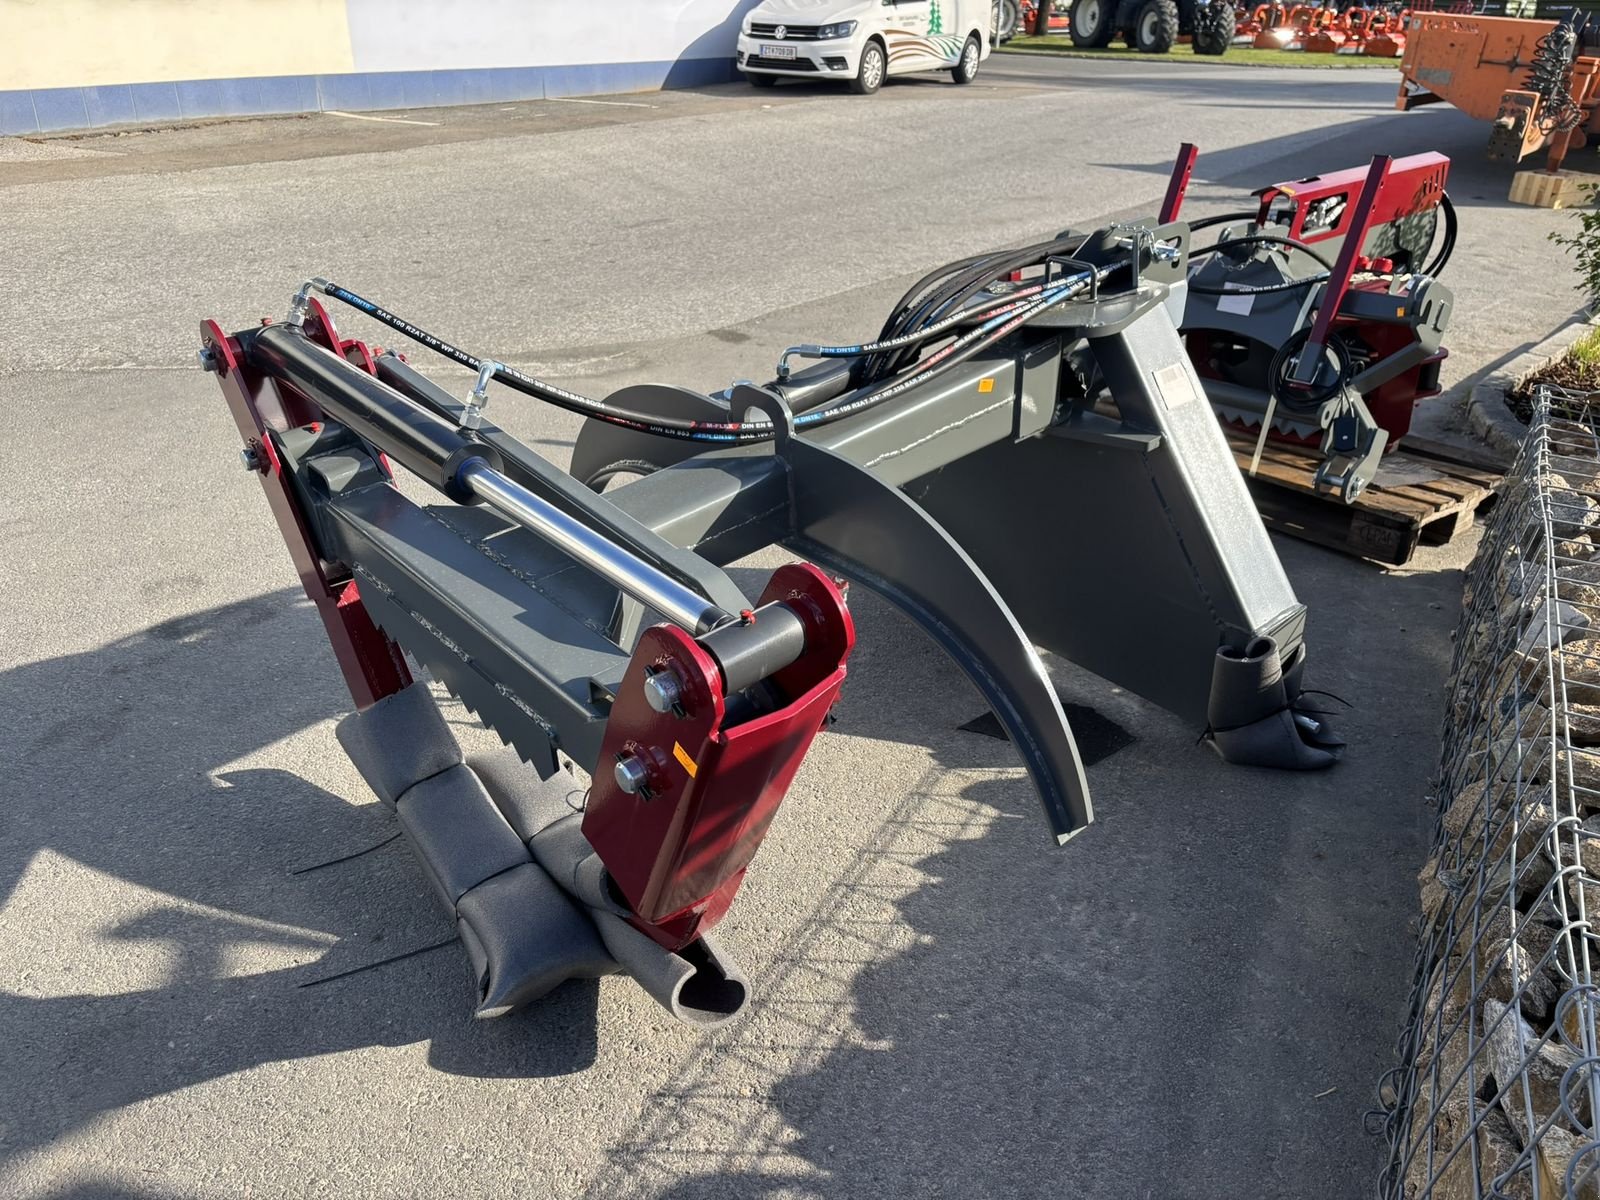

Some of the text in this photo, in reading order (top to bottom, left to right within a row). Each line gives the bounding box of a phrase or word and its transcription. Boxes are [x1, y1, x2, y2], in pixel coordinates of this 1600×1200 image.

[376, 309, 392, 321] SAE
[392, 317, 405, 328] 100
[405, 325, 425, 339] R2AT
[425, 335, 441, 346] 3/8"
[441, 343, 454, 353] WP
[454, 350, 468, 361] 330
[468, 357, 480, 368] BA
[851, 400, 869, 409] R2AT
[893, 385, 905, 393] 330
[904, 379, 918, 389] BAR
